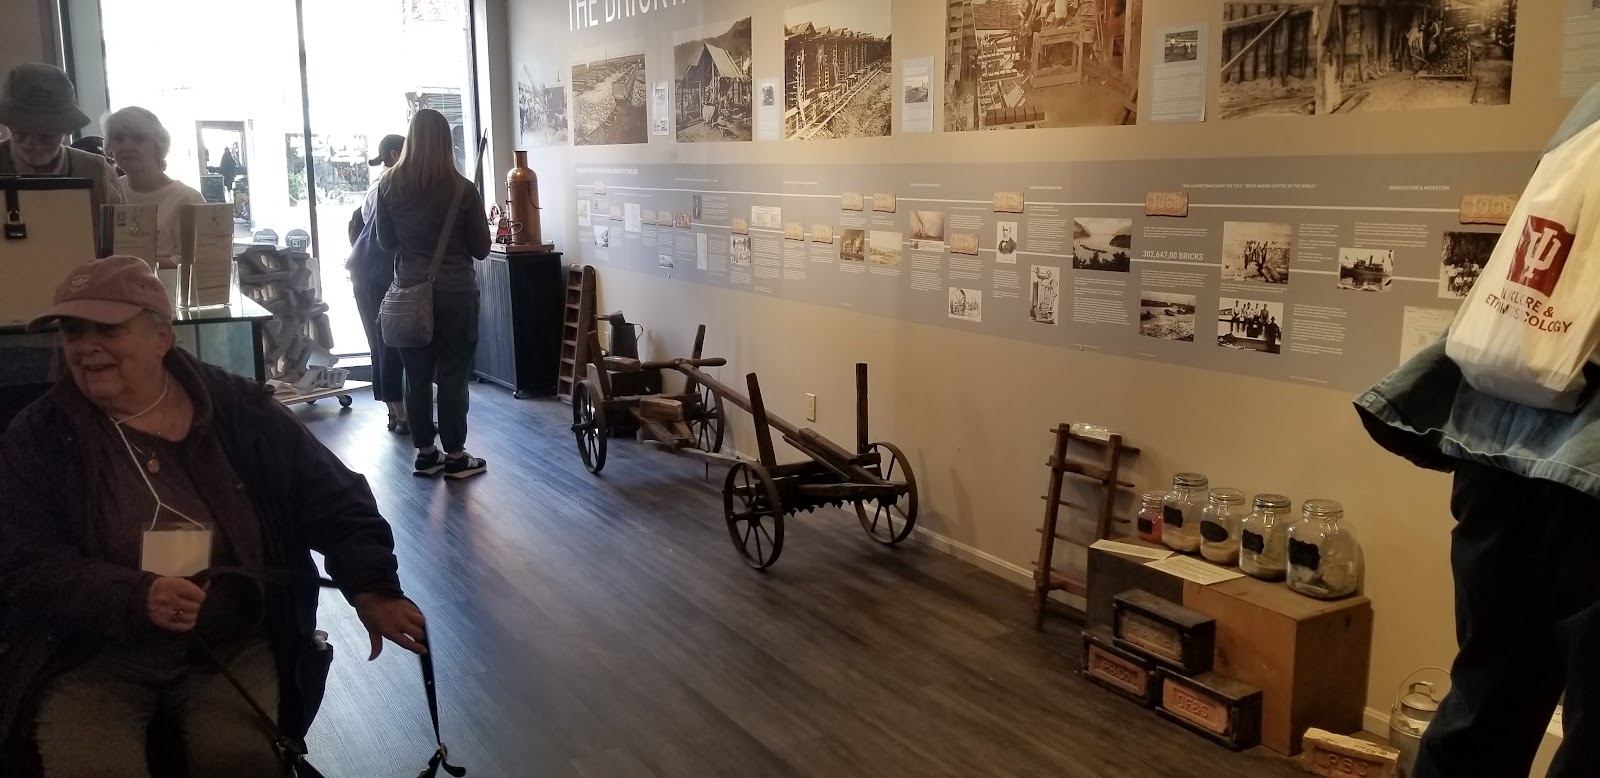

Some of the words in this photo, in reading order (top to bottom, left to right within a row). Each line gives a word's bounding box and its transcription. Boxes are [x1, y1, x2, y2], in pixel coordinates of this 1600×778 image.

[1142, 250, 1178, 260] 302,647,00
[1179, 251, 1204, 261] BRICKS
[1543, 306, 1554, 319] &
